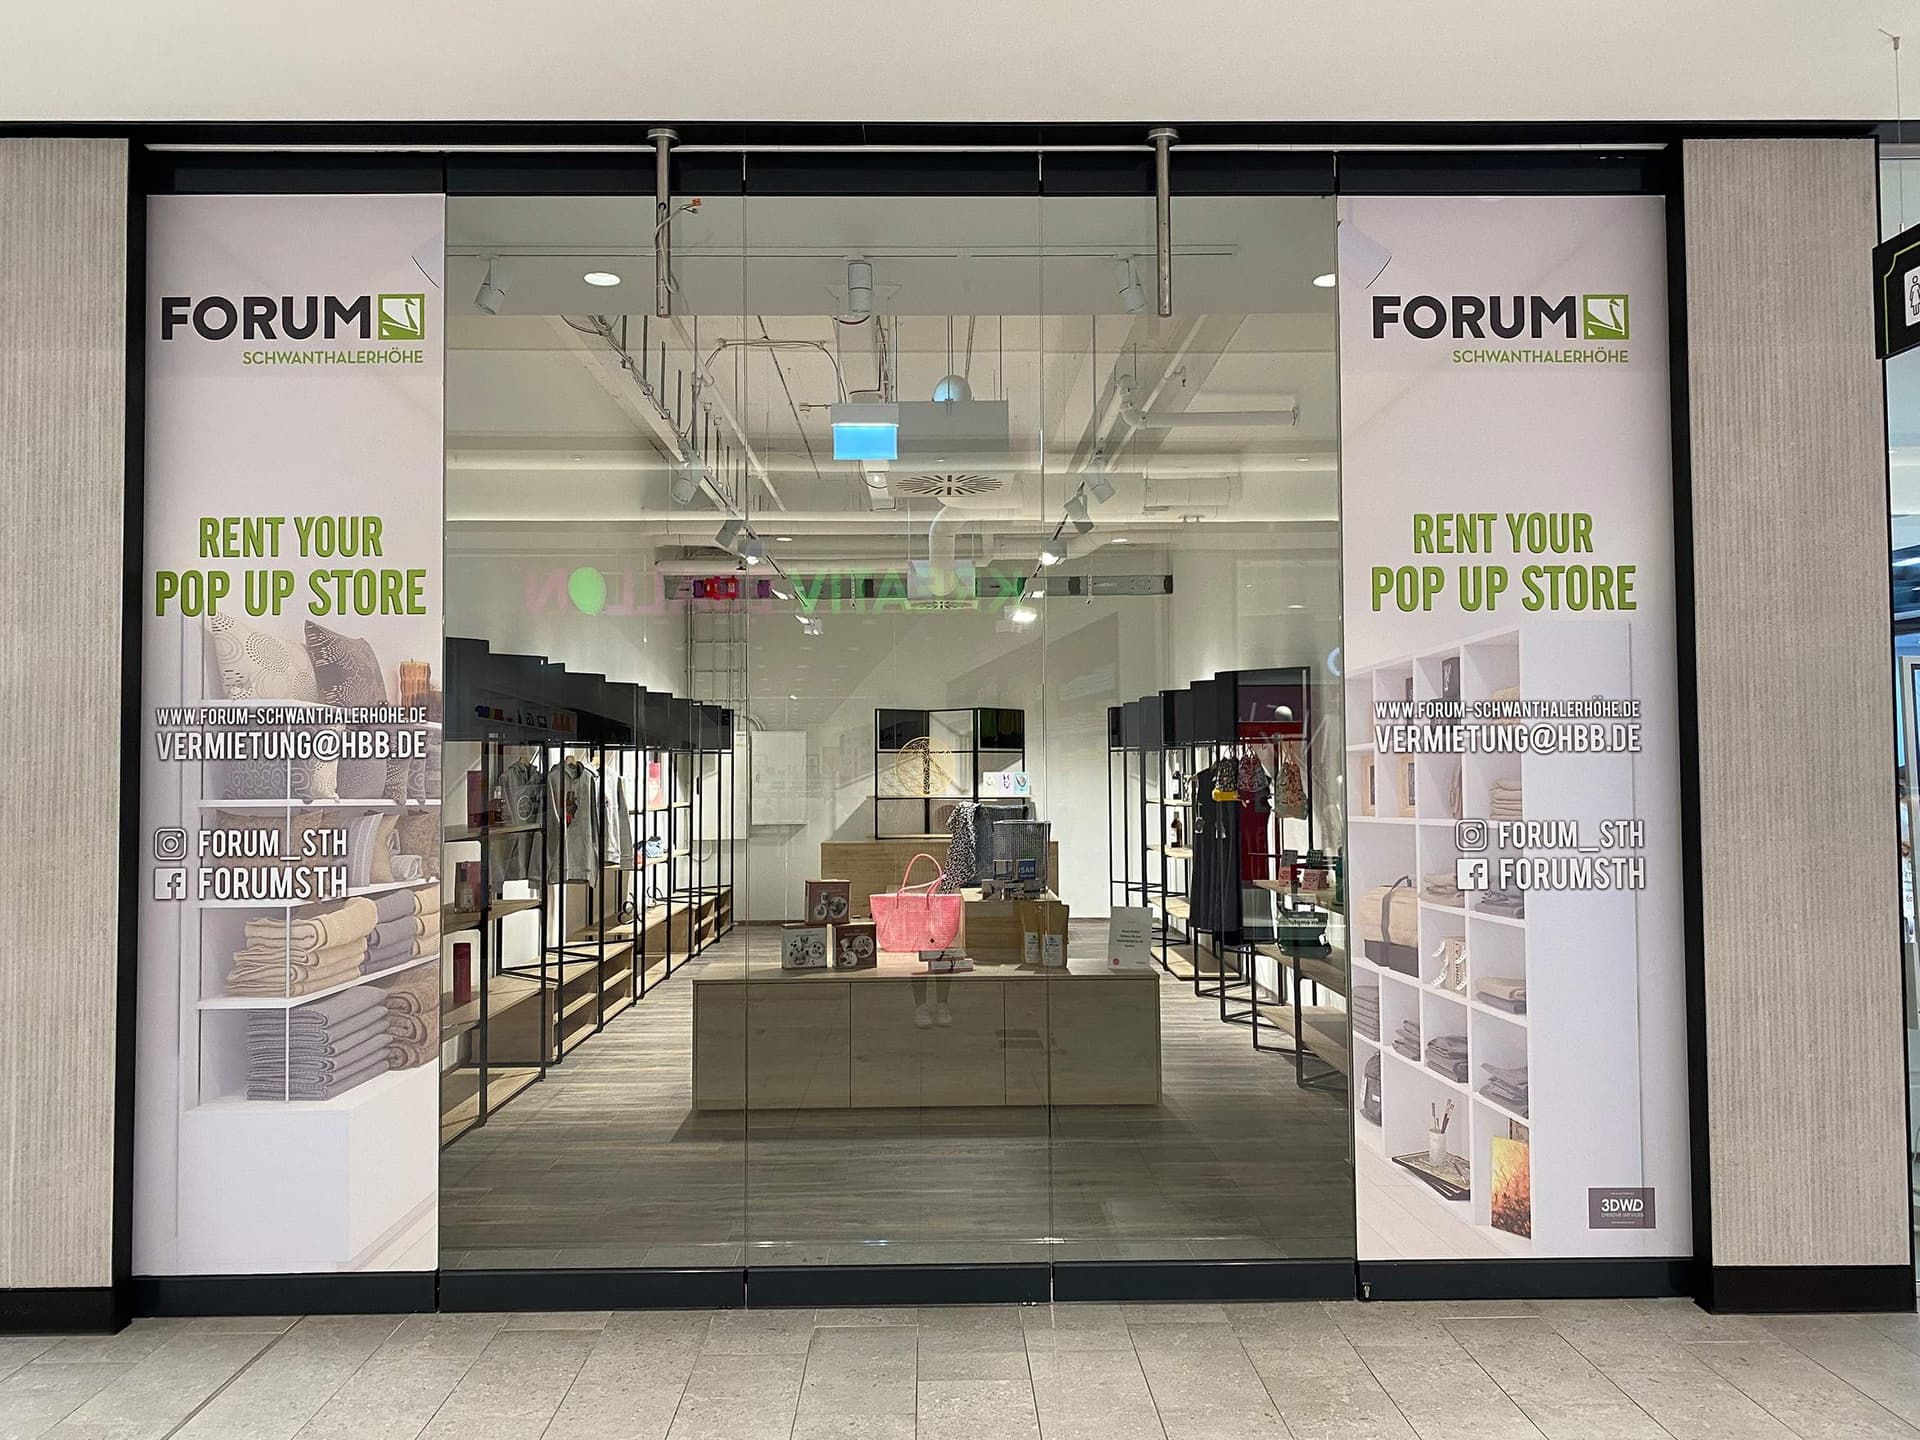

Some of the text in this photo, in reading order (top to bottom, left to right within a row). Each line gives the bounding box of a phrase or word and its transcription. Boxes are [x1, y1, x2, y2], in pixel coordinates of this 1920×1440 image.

[161, 296, 371, 340] FORUM
[1372, 295, 1577, 339] FORUM
[242, 347, 424, 364] SCHWANTHALERHÖHE
[1452, 347, 1629, 363] SCHWANTHALERHÖHE
[199, 515, 383, 558] RENT YOUR
[1413, 512, 1594, 554] RENT YOUR
[155, 568, 427, 617] POP UP STORE
[1371, 564, 1638, 612] POP UP STORE
[155, 702, 427, 726] WWW.FORUM-SCHWANTHALERHÖHE.DE
[1374, 696, 1640, 719] WWW.FORUM-SCHWANTHALERHÖHE.DE
[156, 730, 427, 760] VERMIETUNG@HBB.DE
[1375, 723, 1642, 754] VERMIETUNG@HBB.DE
[198, 829, 348, 861] FORUM_STH
[1498, 820, 1644, 852] FORUM_STH
[198, 865, 348, 900] FORUMSTH
[1499, 857, 1646, 890] FORUMSTH
[1601, 1198, 1644, 1212] 3DWD
